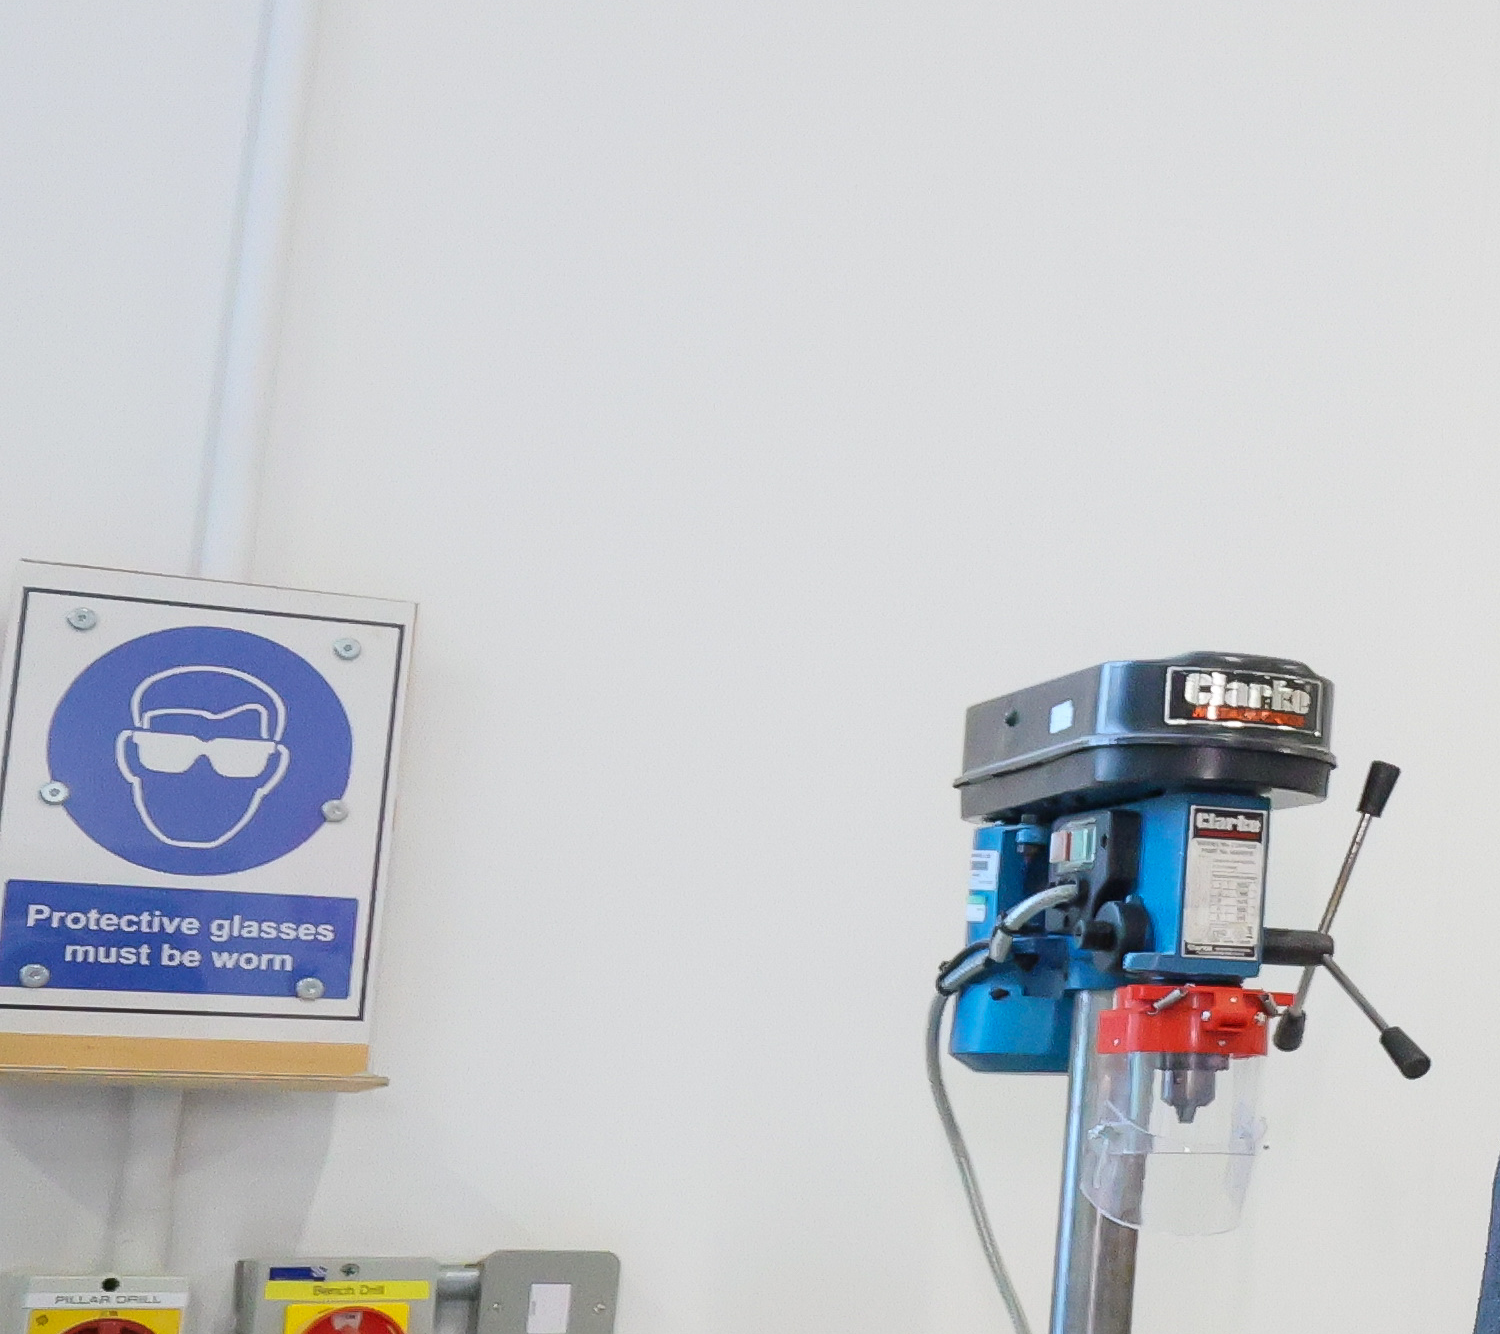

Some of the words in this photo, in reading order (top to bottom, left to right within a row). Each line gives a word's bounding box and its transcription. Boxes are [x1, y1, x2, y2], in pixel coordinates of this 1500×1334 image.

[1184, 671, 1311, 715] Clarke
[1196, 812, 1262, 833] Clarke
[26, 903, 201, 935] Protective
[210, 915, 336, 942] glasses
[64, 943, 152, 966] must
[160, 943, 203, 968] be
[210, 951, 294, 972] worn
[54, 1295, 111, 1305] PILLAR
[116, 1295, 162, 1305] DRILL
